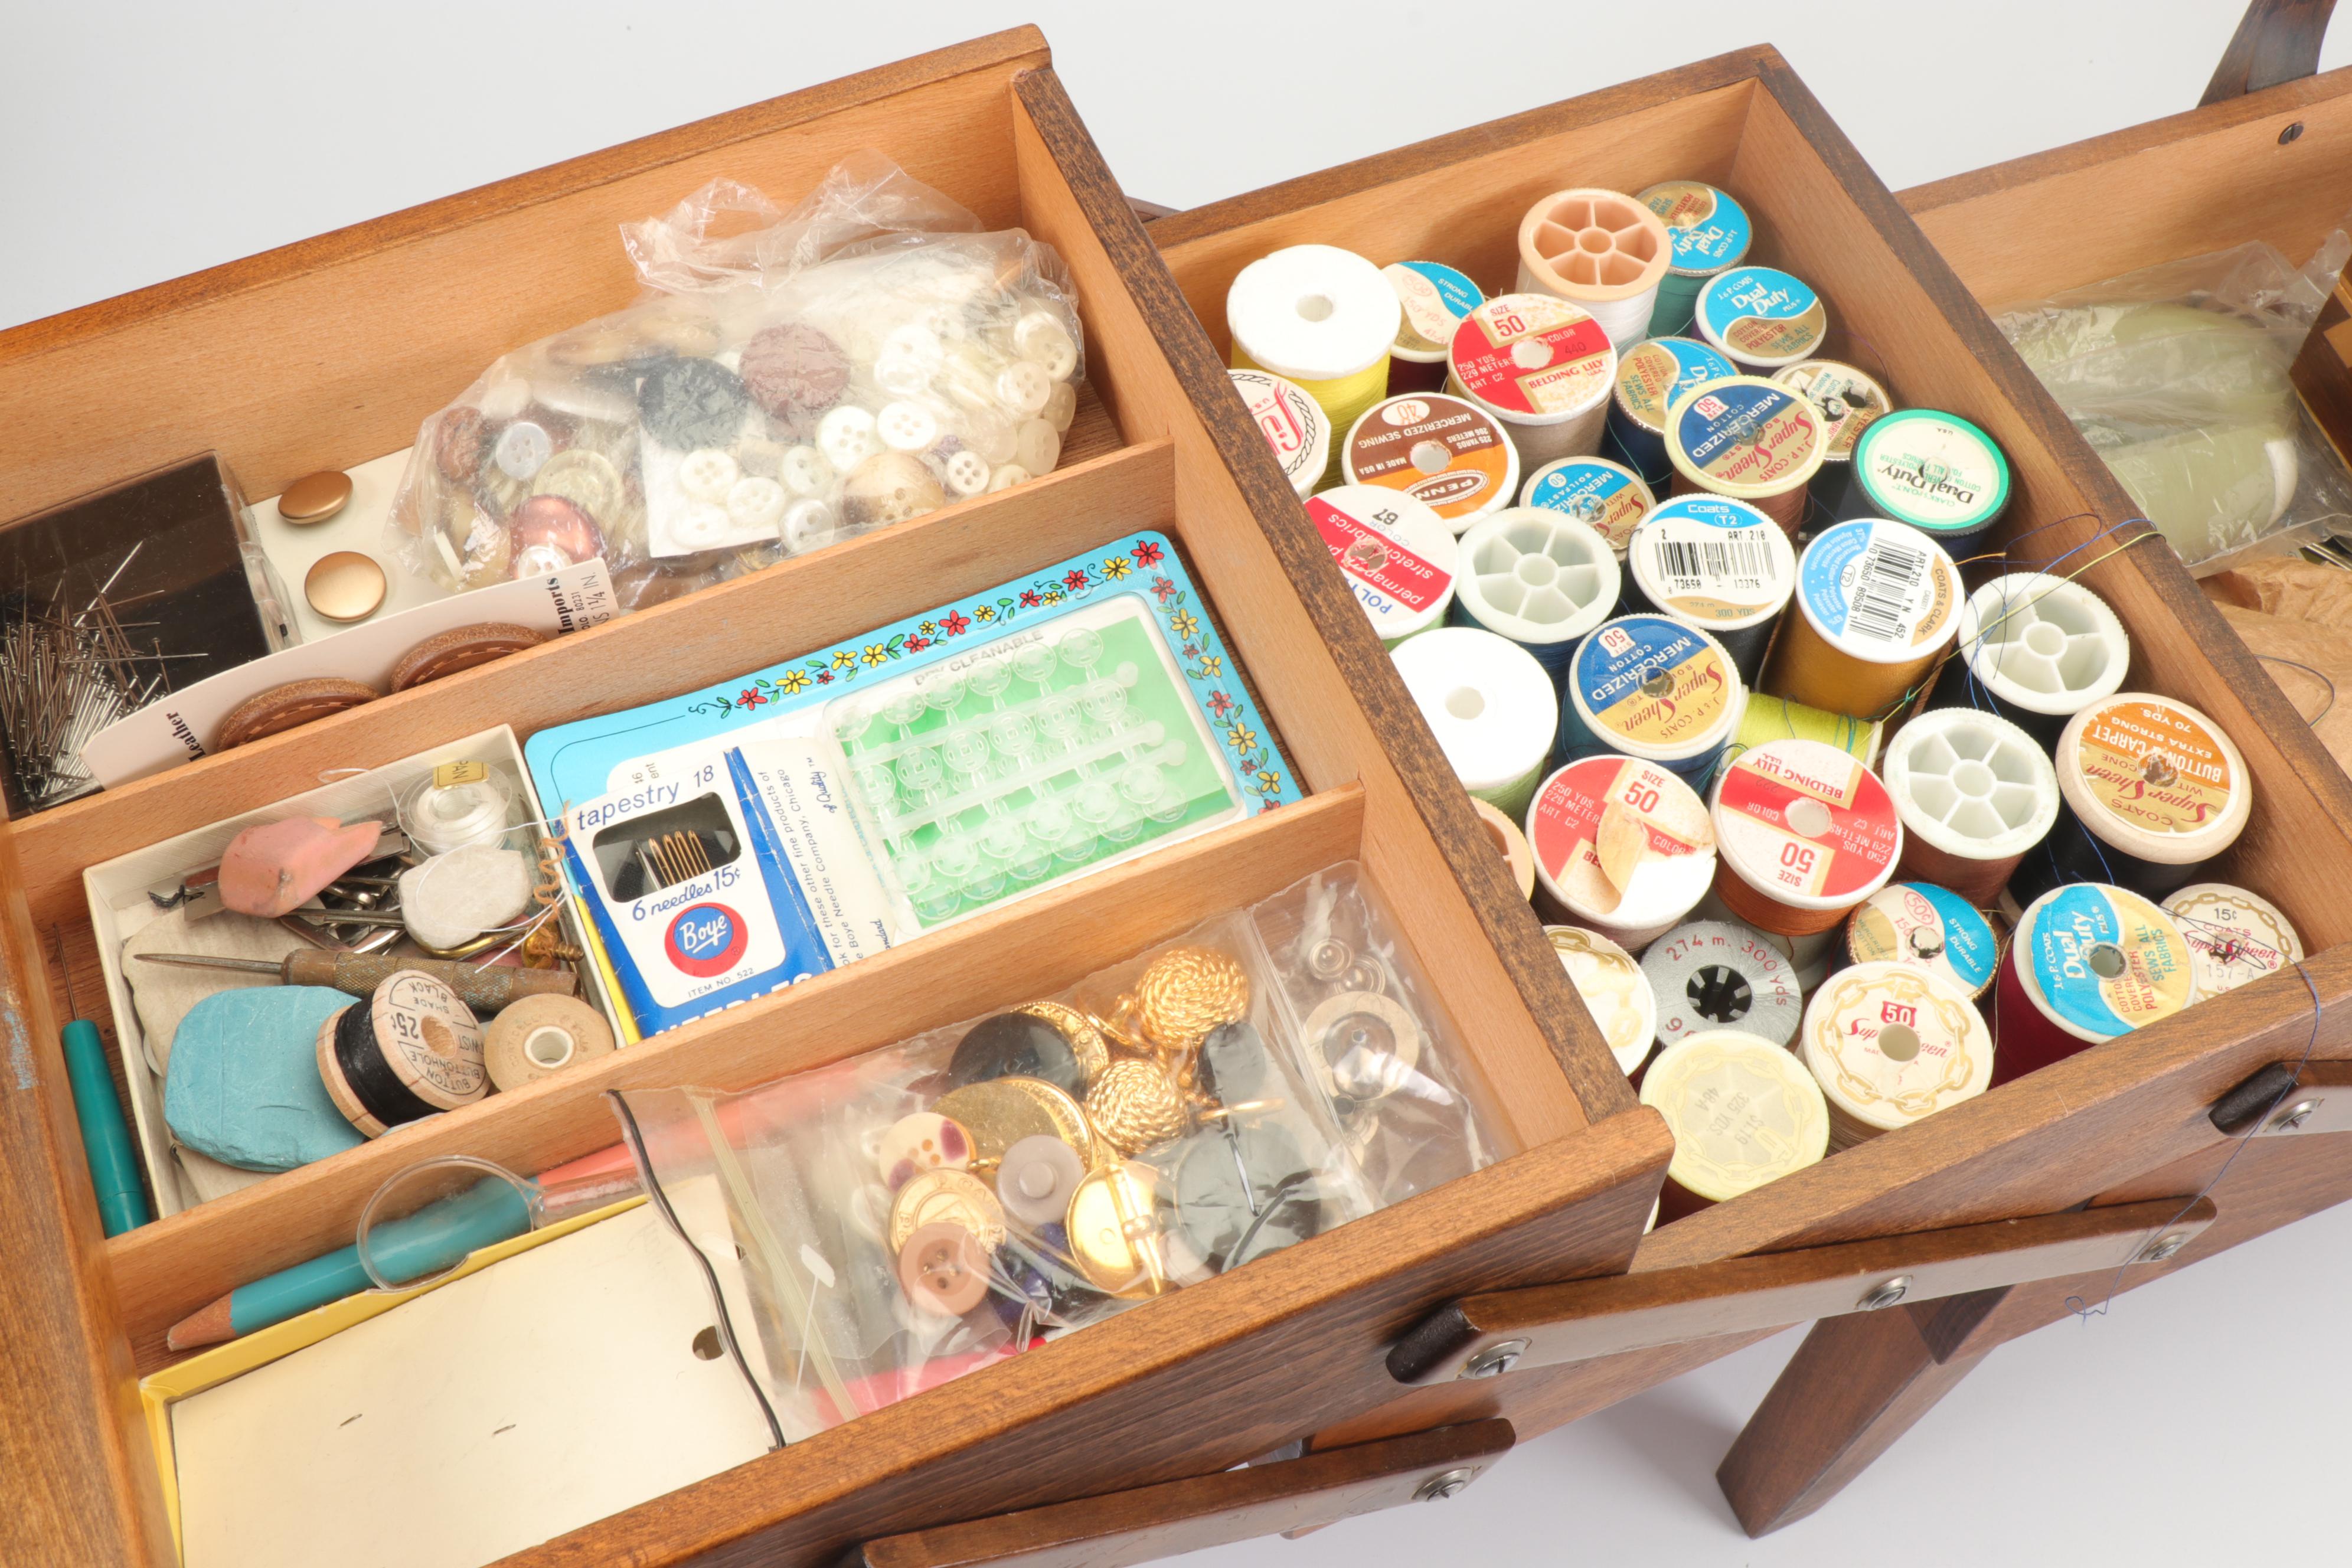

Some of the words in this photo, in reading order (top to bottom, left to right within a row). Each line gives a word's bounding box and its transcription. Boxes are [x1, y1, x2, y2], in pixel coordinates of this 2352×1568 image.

[1696, 226, 1724, 255] Dual
[1438, 278, 1468, 298] STRONG
[1731, 282, 1768, 309] Dual
[1444, 292, 1474, 311] DURABL
[1490, 305, 1511, 316] SIZE
[1752, 288, 1790, 315] Duty
[1494, 315, 1526, 337] 50
[1547, 328, 1576, 343] COLOR
[1733, 321, 1758, 338] COTTON
[1740, 324, 1768, 343] COVERED
[1746, 324, 1786, 350] POLYESTER
[1770, 334, 1794, 349] SEWS
[1795, 325, 1810, 335] ALL
[1783, 332, 1814, 353] FABRICS
[1457, 360, 1475, 371] 250
[1461, 368, 1479, 380] 229
[1480, 357, 1514, 375] METERS
[1528, 364, 1580, 389] BELDING
[1582, 359, 1605, 374] LILY
[1633, 357, 1658, 397] POLYESTER
[1644, 356, 1662, 383] COVERED
[1652, 354, 1668, 377] COTTON
[1492, 373, 1505, 383] C2
[1623, 380, 1643, 410] FABRICS
[1630, 374, 1647, 396] SEWS
[1643, 398, 1655, 412] ALL
[1397, 403, 1417, 415] 40
[1698, 398, 1717, 412] 50
[1709, 405, 1724, 418] SIZE
[1404, 413, 1472, 437] MERCERIZED
[1692, 393, 1781, 458] MERCERIZED
[1706, 404, 1744, 432] COTTON
[1358, 431, 1402, 449] SEWING
[1446, 430, 1475, 443] METERS
[1769, 411, 1814, 450] Super
[1457, 439, 1479, 449] YARDS
[1359, 465, 1376, 475] USA
[1388, 457, 1407, 467] MADE
[1759, 459, 1789, 482] COATS
[1550, 475, 1564, 486] 50
[1881, 465, 1927, 489] Duty
[1955, 478, 1981, 492] COTTON
[1929, 482, 1974, 504] Dual
[1373, 508, 1399, 525] 87
[1608, 494, 1644, 525] Super
[1688, 504, 1730, 513] Coats
[1719, 515, 1737, 524] T2
[1369, 520, 1410, 547] COLOR
[1661, 529, 1667, 540] 2
[580, 572, 599, 589] IN.
[1841, 570, 1853, 582] T2
[1860, 557, 1876, 581] 73650
[1734, 579, 1760, 589] 13376
[1935, 569, 1947, 599] COATS
[545, 577, 576, 635] Imports
[571, 592, 584, 611] 80231
[1851, 587, 1867, 612] 89508
[1716, 609, 1733, 618] 300
[1919, 609, 1942, 635] CLARK
[1605, 630, 1625, 647] 50
[1894, 623, 1906, 639] 452
[949, 629, 1044, 672] CLEANABLE
[1609, 645, 1652, 672] COTTON
[1614, 641, 1632, 655] SIZE
[1592, 636, 1692, 701] MERCERIZED
[1674, 661, 1723, 701] Super
[1623, 698, 1676, 731] Sheen
[166, 712, 207, 762] Leather
[1660, 714, 1693, 739] COATS
[2111, 716, 2168, 741] STRONG
[2175, 721, 2191, 733] 70
[2092, 724, 2147, 755] CARPET
[2170, 739, 2213, 759] EXTRA
[757, 771, 770, 783] of
[1753, 757, 1780, 774] LILY
[2165, 752, 2222, 783] BUTTON
[1551, 782, 1572, 798] 250
[1641, 770, 1665, 788] SIZE
[1783, 773, 1844, 799] BELDING
[2086, 763, 2145, 800] Sheen
[577, 779, 680, 831] tapestry
[692, 765, 716, 789] 18
[776, 769, 802, 813] Chicago
[1545, 790, 1563, 805] 229
[1624, 780, 1660, 814] 50
[766, 784, 794, 834] products
[1747, 802, 1779, 821] COLOR
[2111, 798, 2173, 827] COATS
[2148, 790, 2217, 823] Super
[1564, 816, 1580, 829] C2
[1853, 818, 1868, 829] C2
[788, 837, 805, 858] fine
[798, 815, 826, 873] Company,
[1653, 834, 1684, 855] COLOR
[1871, 841, 1893, 855] 229
[1780, 842, 1815, 874] 50
[1866, 851, 1887, 865] 250
[802, 860, 818, 893] other
[1778, 870, 1802, 887] SIZE
[631, 900, 647, 922] 6
[650, 881, 714, 917] needles
[713, 864, 741, 891] 15¢
[822, 876, 844, 918] Needle
[814, 896, 834, 929] these
[2214, 908, 2237, 921] 15¢
[679, 914, 729, 952] Boye
[832, 932, 843, 949] for
[841, 921, 860, 949] Boye
[1948, 918, 1978, 951] STRONG
[2135, 925, 2151, 945] ALL
[2203, 923, 2252, 936] COATS
[1666, 935, 1703, 961] 274
[1741, 939, 1778, 972] 300
[1856, 930, 1875, 956] COTTON
[2042, 932, 2057, 964] COATS
[2053, 930, 2087, 979] Dual
[2151, 929, 2177, 974] FABRICS
[1949, 936, 1982, 974] DURABLE
[2144, 950, 2165, 982] SEWS
[687, 982, 713, 998] ITEM
[716, 975, 736, 988] NO.
[736, 967, 755, 982] 522
[2129, 950, 2158, 1010] POLYESTER
[409, 982, 447, 1002] BLACK
[414, 997, 449, 1014] SHADE
[1885, 1004, 1911, 1026] 50
[459, 1034, 484, 1055] TWIST
[411, 1050, 481, 1079] BUTTONHOLE
[426, 1067, 471, 1089] BUTTON
[1695, 1087, 1720, 1112] 48-A
[1727, 1092, 1750, 1114] 325
